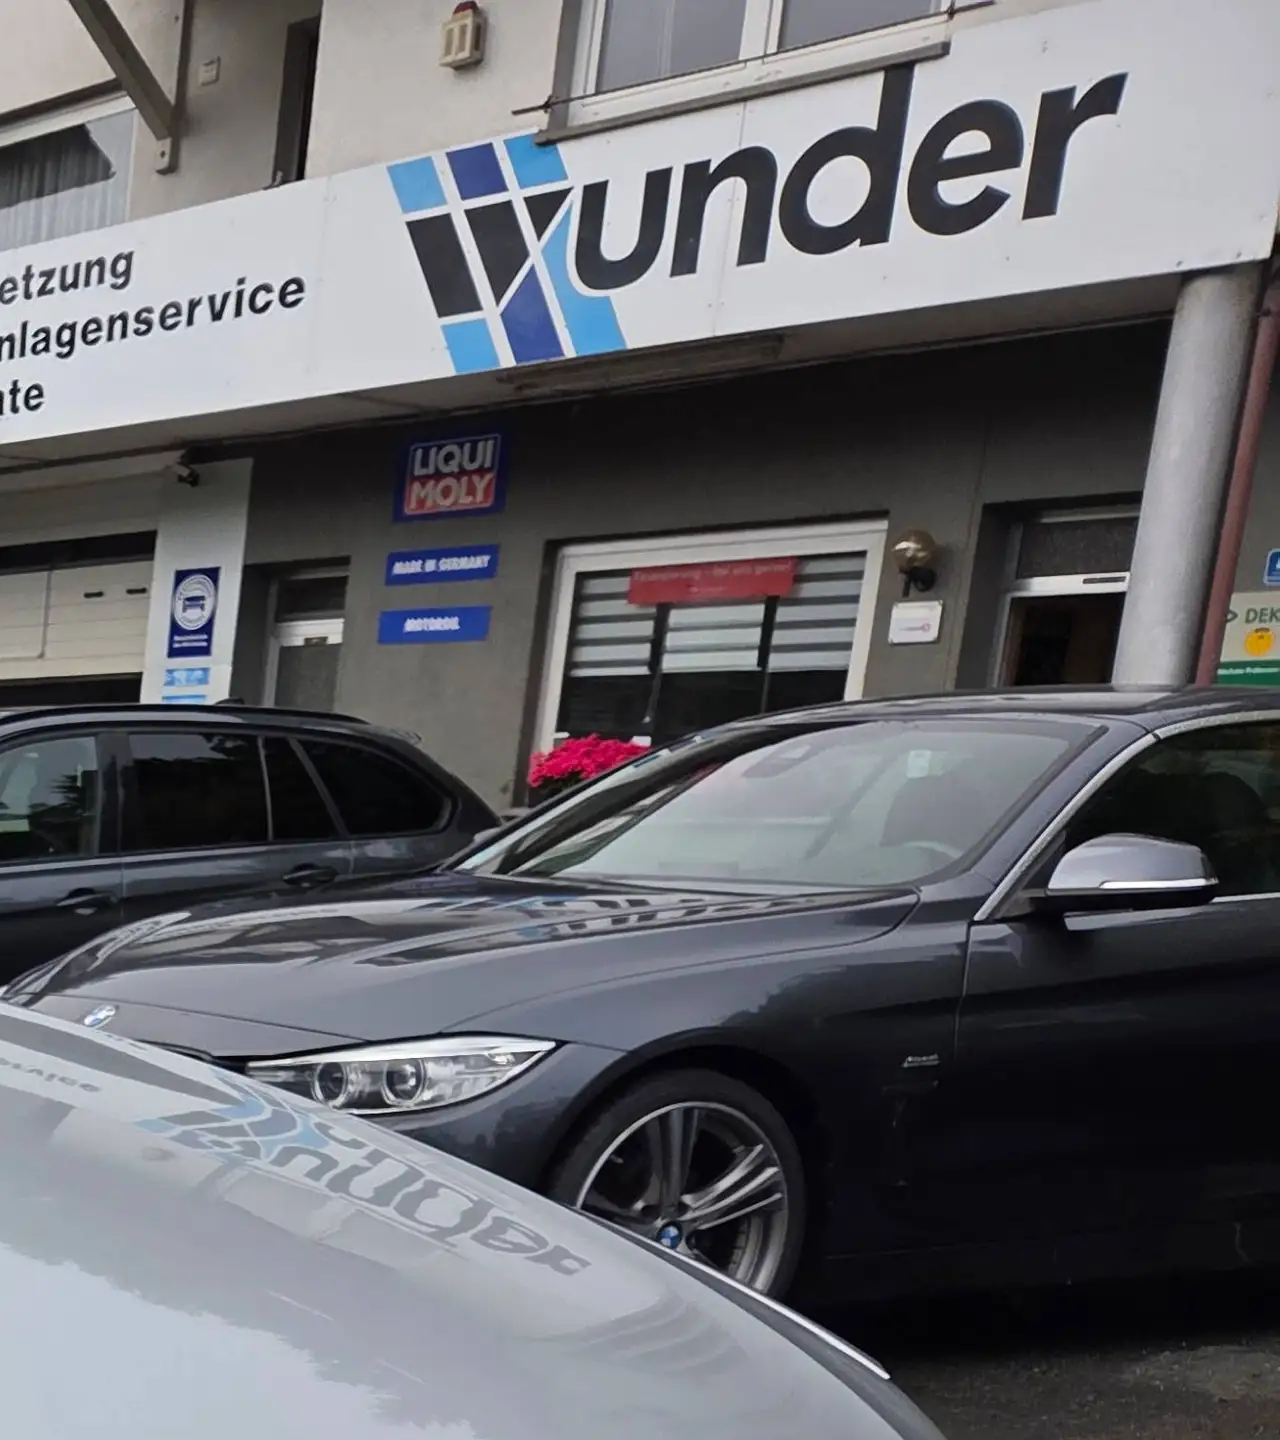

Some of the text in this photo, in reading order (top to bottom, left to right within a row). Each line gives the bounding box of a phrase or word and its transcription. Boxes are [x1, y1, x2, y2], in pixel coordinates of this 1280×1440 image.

[387, 65, 1128, 372] Wunder
[414, 439, 496, 476] LIQUI
[409, 473, 495, 510] MOLY
